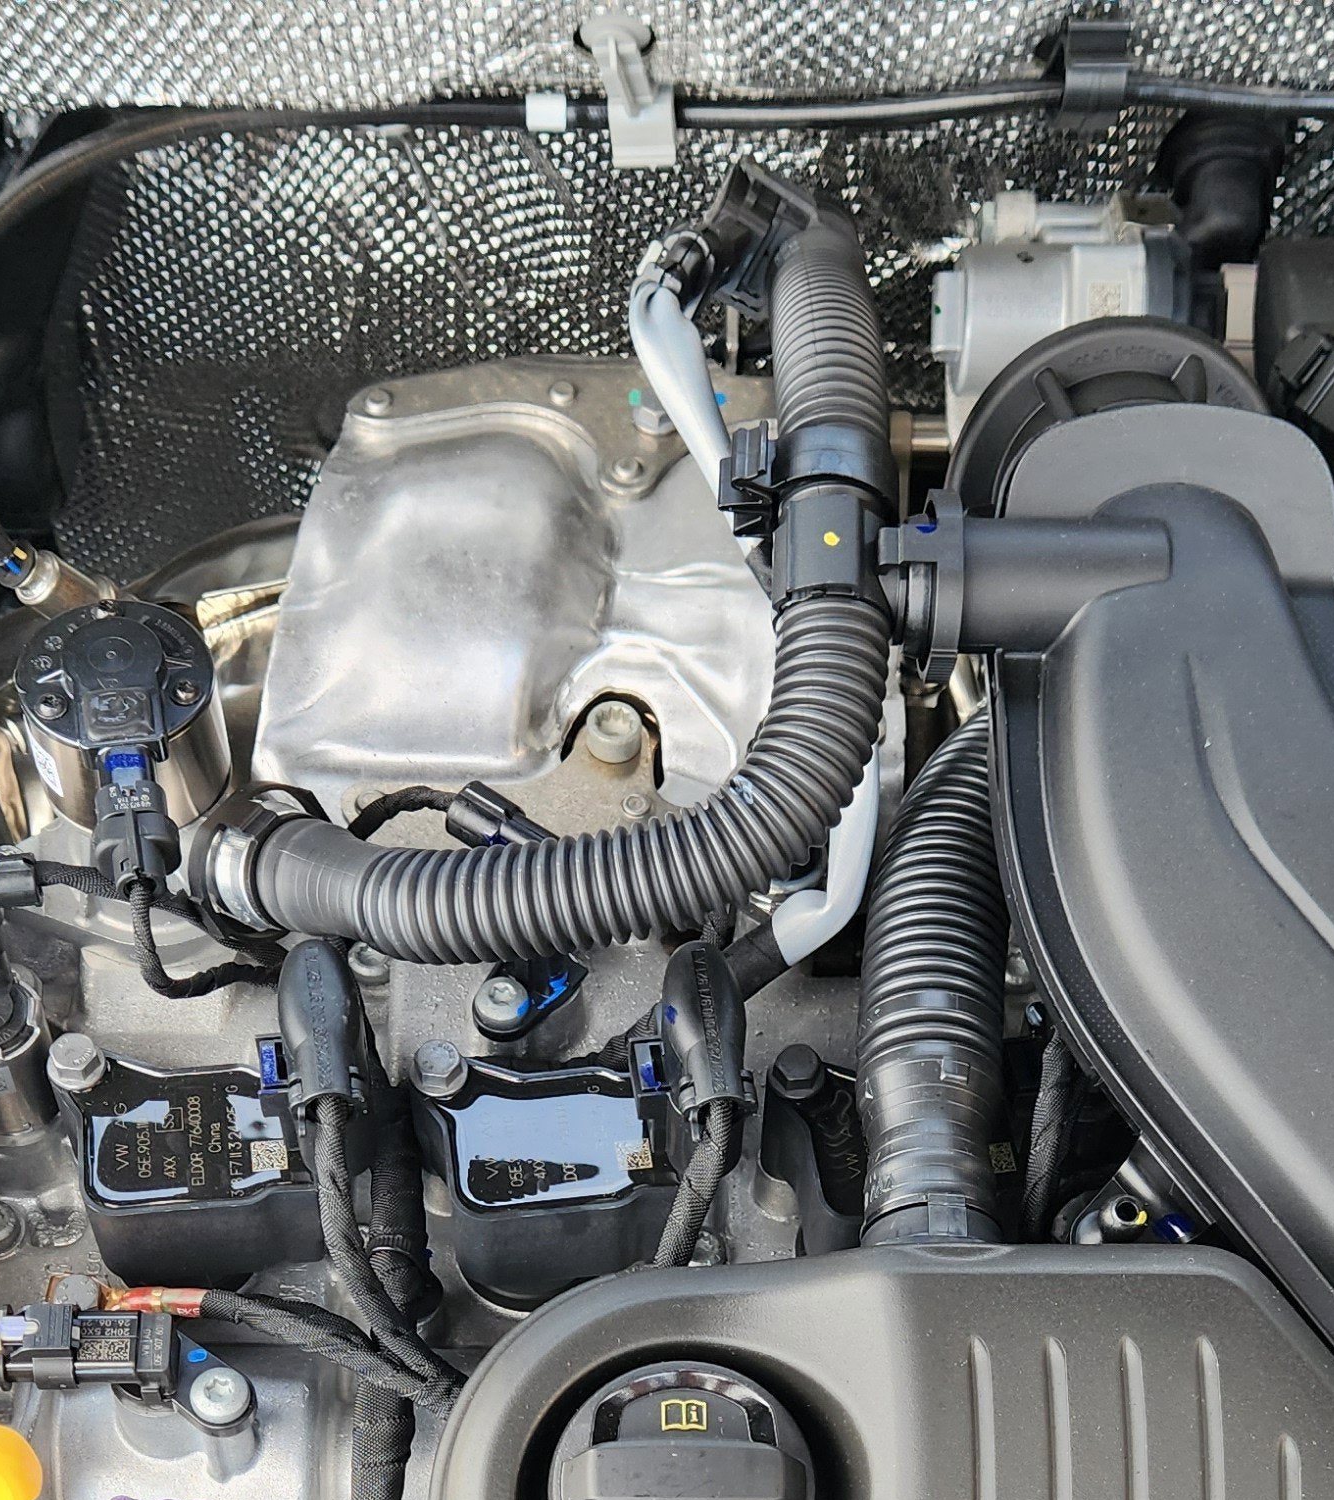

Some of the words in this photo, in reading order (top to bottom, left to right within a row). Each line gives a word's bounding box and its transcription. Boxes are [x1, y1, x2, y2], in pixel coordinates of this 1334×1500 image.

[208, 1122, 222, 1153] China
[115, 1143, 130, 1171] VW
[162, 1155, 177, 1179] 4XX
[189, 1152, 206, 1186] ELDOR
